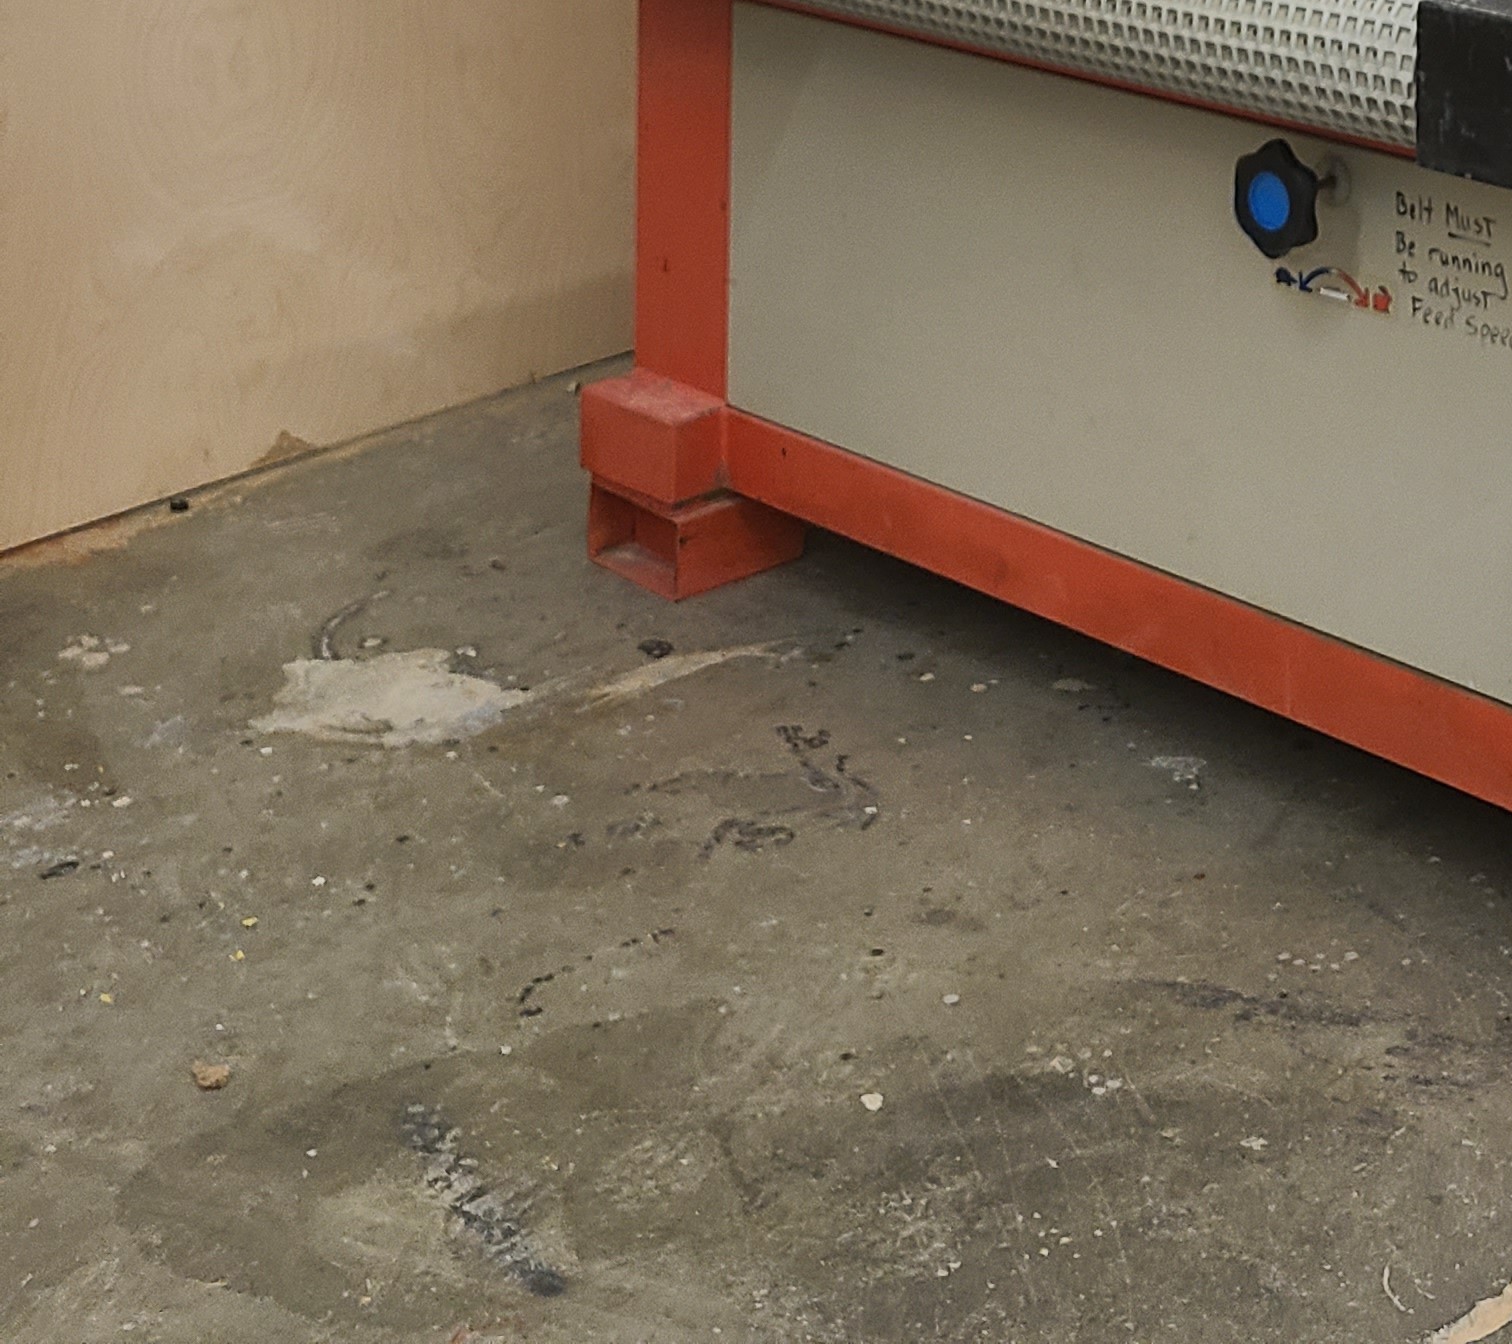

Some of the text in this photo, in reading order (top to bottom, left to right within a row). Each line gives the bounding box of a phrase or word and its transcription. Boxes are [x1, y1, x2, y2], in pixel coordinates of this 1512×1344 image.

[1395, 191, 1497, 238] Belt Must
[1395, 229, 1509, 300] Be running
[1398, 261, 1498, 311] to adjust
[1411, 295, 1455, 331] Feed
